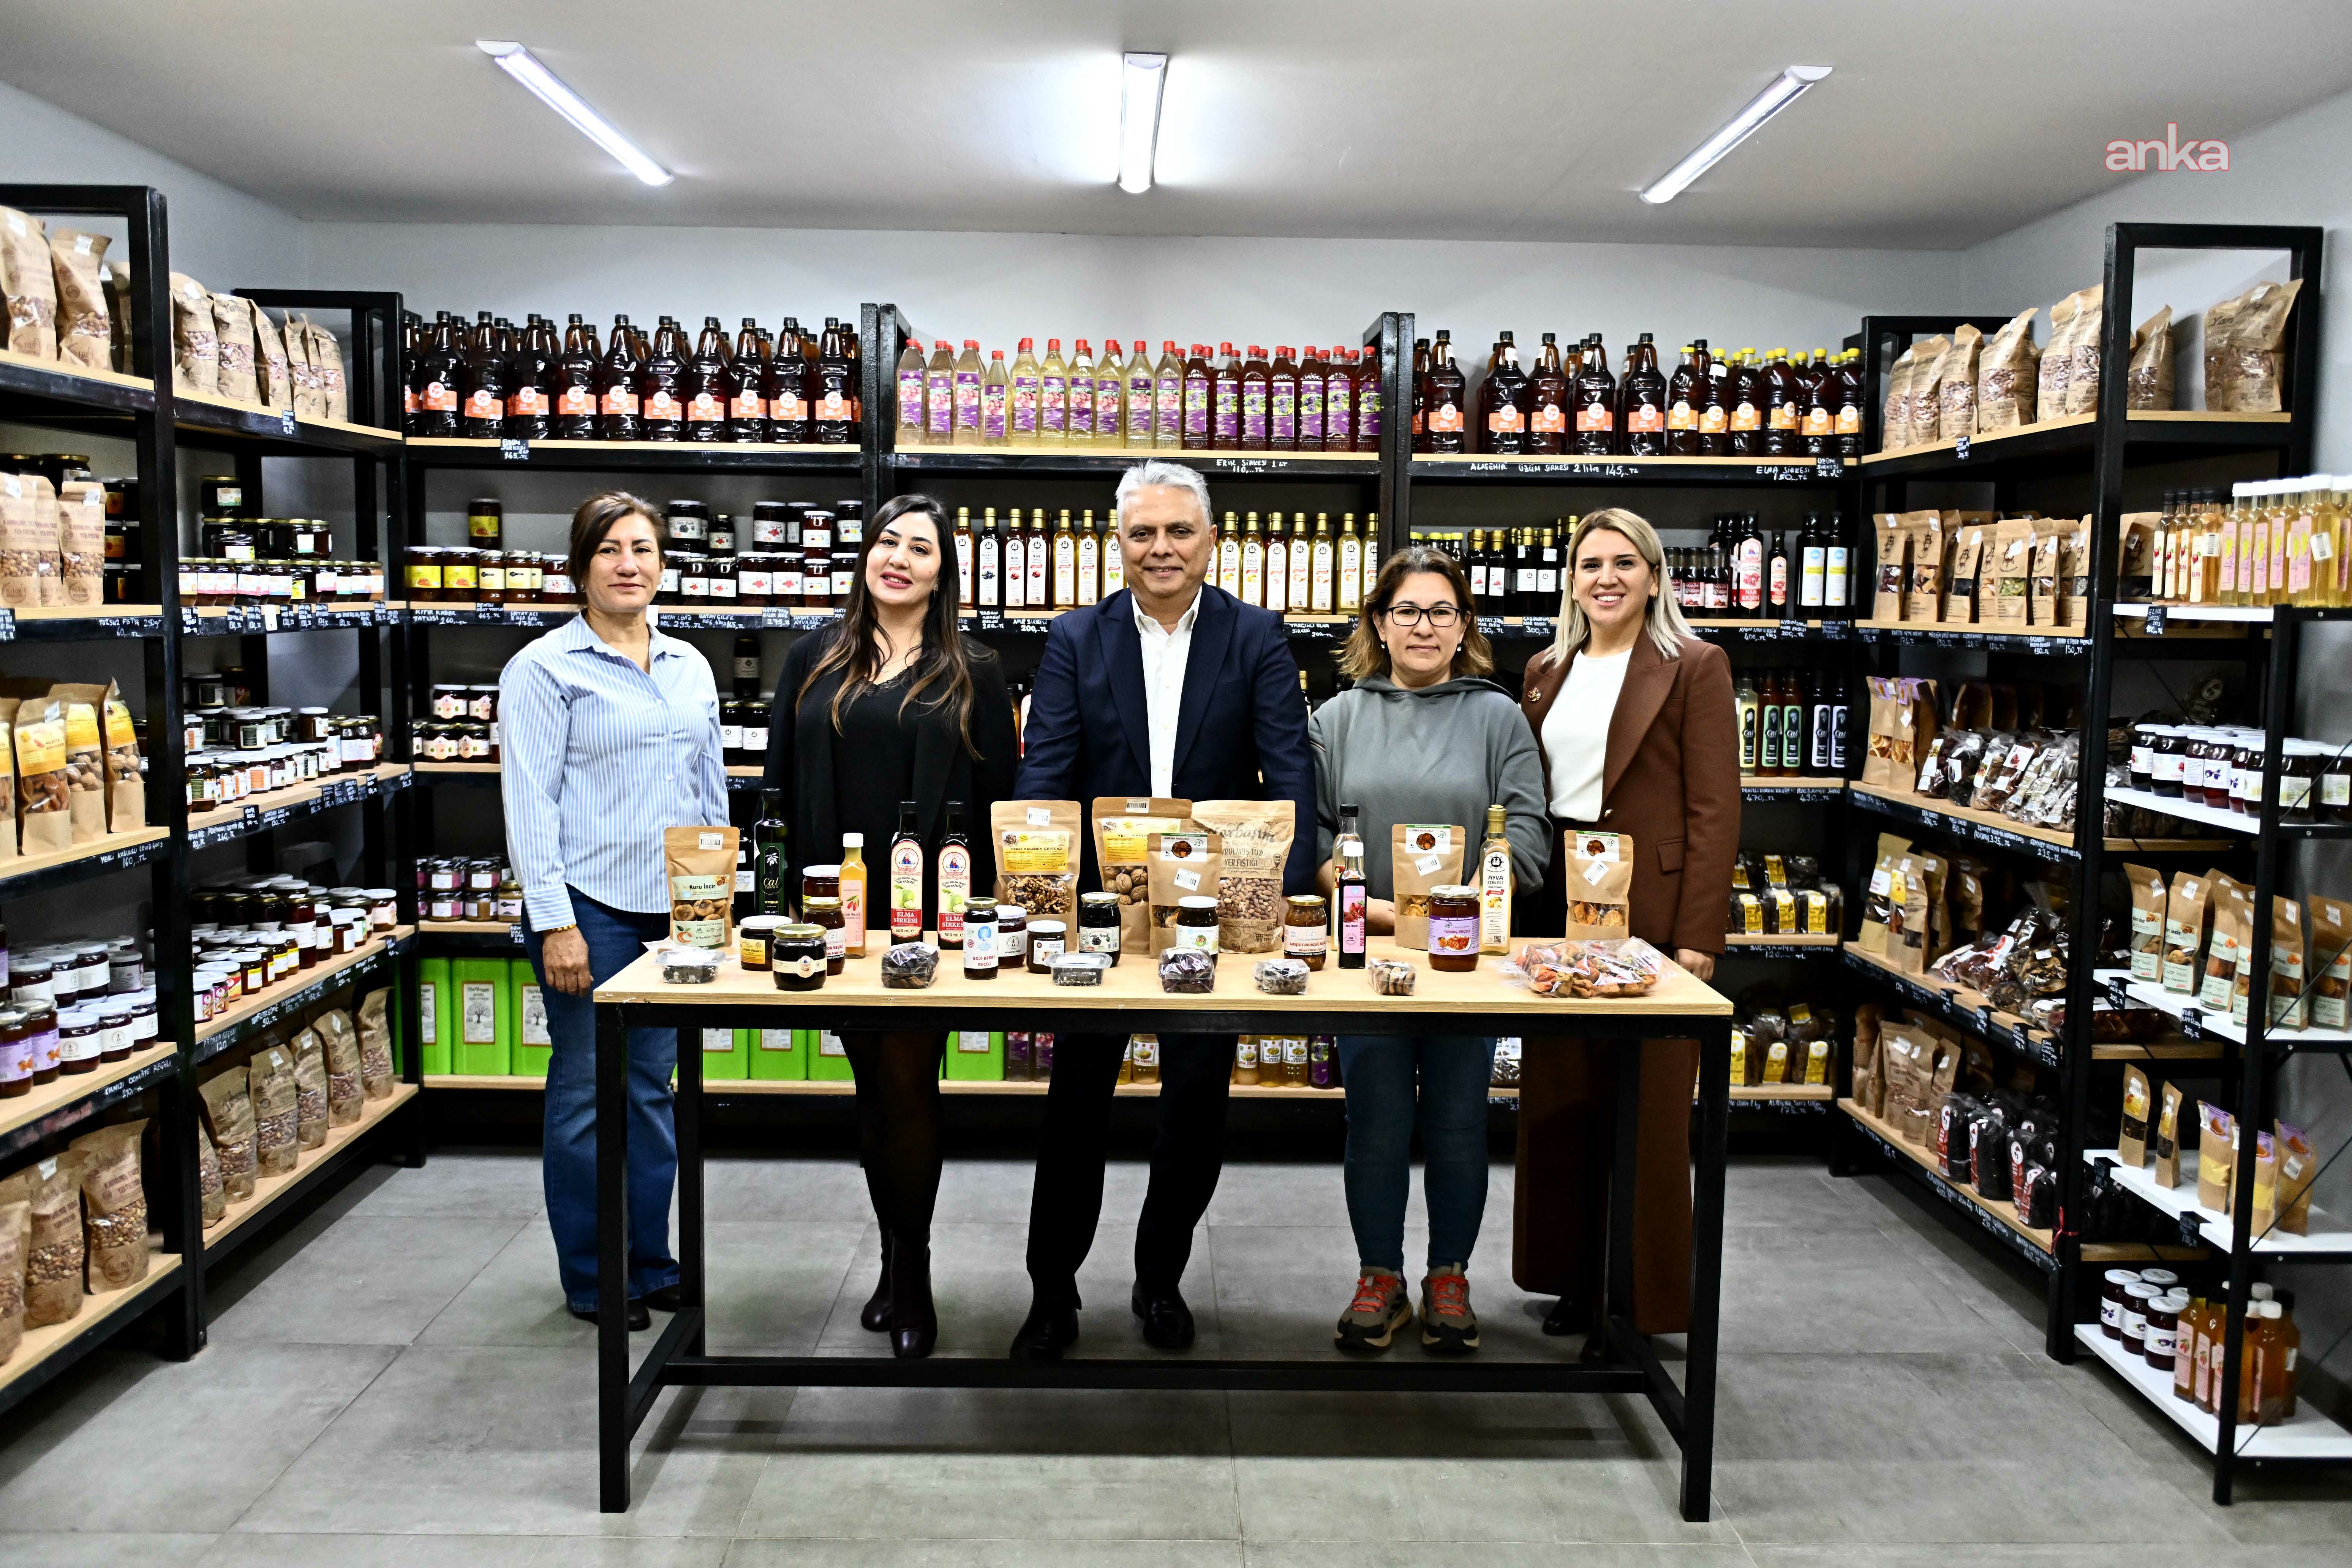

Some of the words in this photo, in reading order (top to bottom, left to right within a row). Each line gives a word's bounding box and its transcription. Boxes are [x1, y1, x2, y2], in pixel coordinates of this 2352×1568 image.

[1573, 464, 1581, 473] 2
[1584, 464, 1600, 473] litre
[763, 877, 779, 886] Cal
